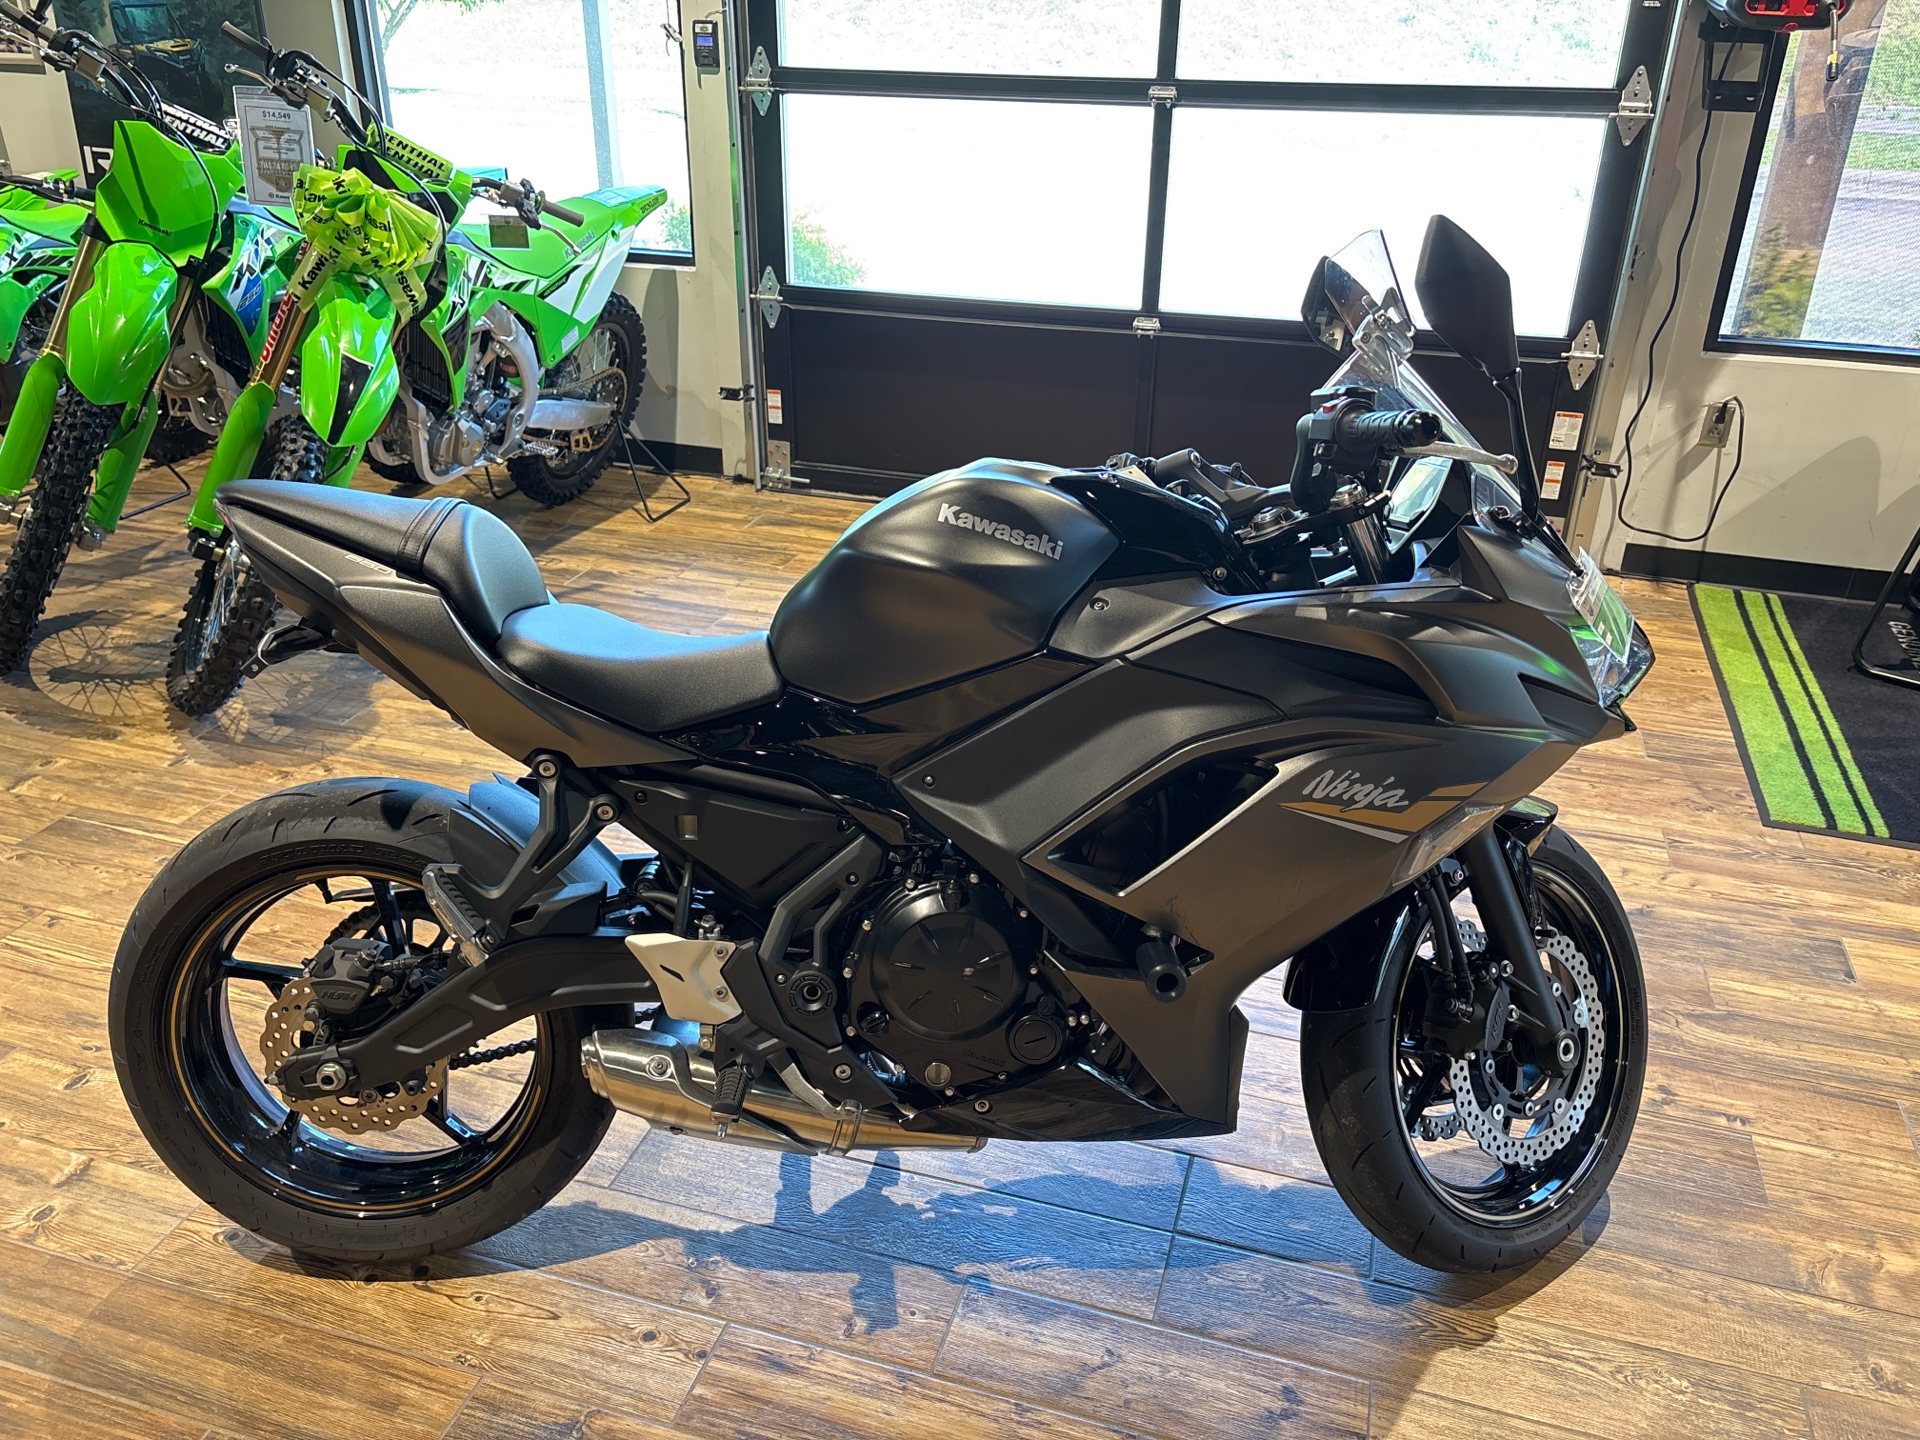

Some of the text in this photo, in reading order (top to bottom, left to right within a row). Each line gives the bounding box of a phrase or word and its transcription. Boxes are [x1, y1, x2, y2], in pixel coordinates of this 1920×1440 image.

[262, 110, 291, 120] $14,549
[138, 218, 172, 238] Kawasaki
[937, 502, 1064, 560] Kawasaki
[1302, 769, 1409, 813] Ninja
